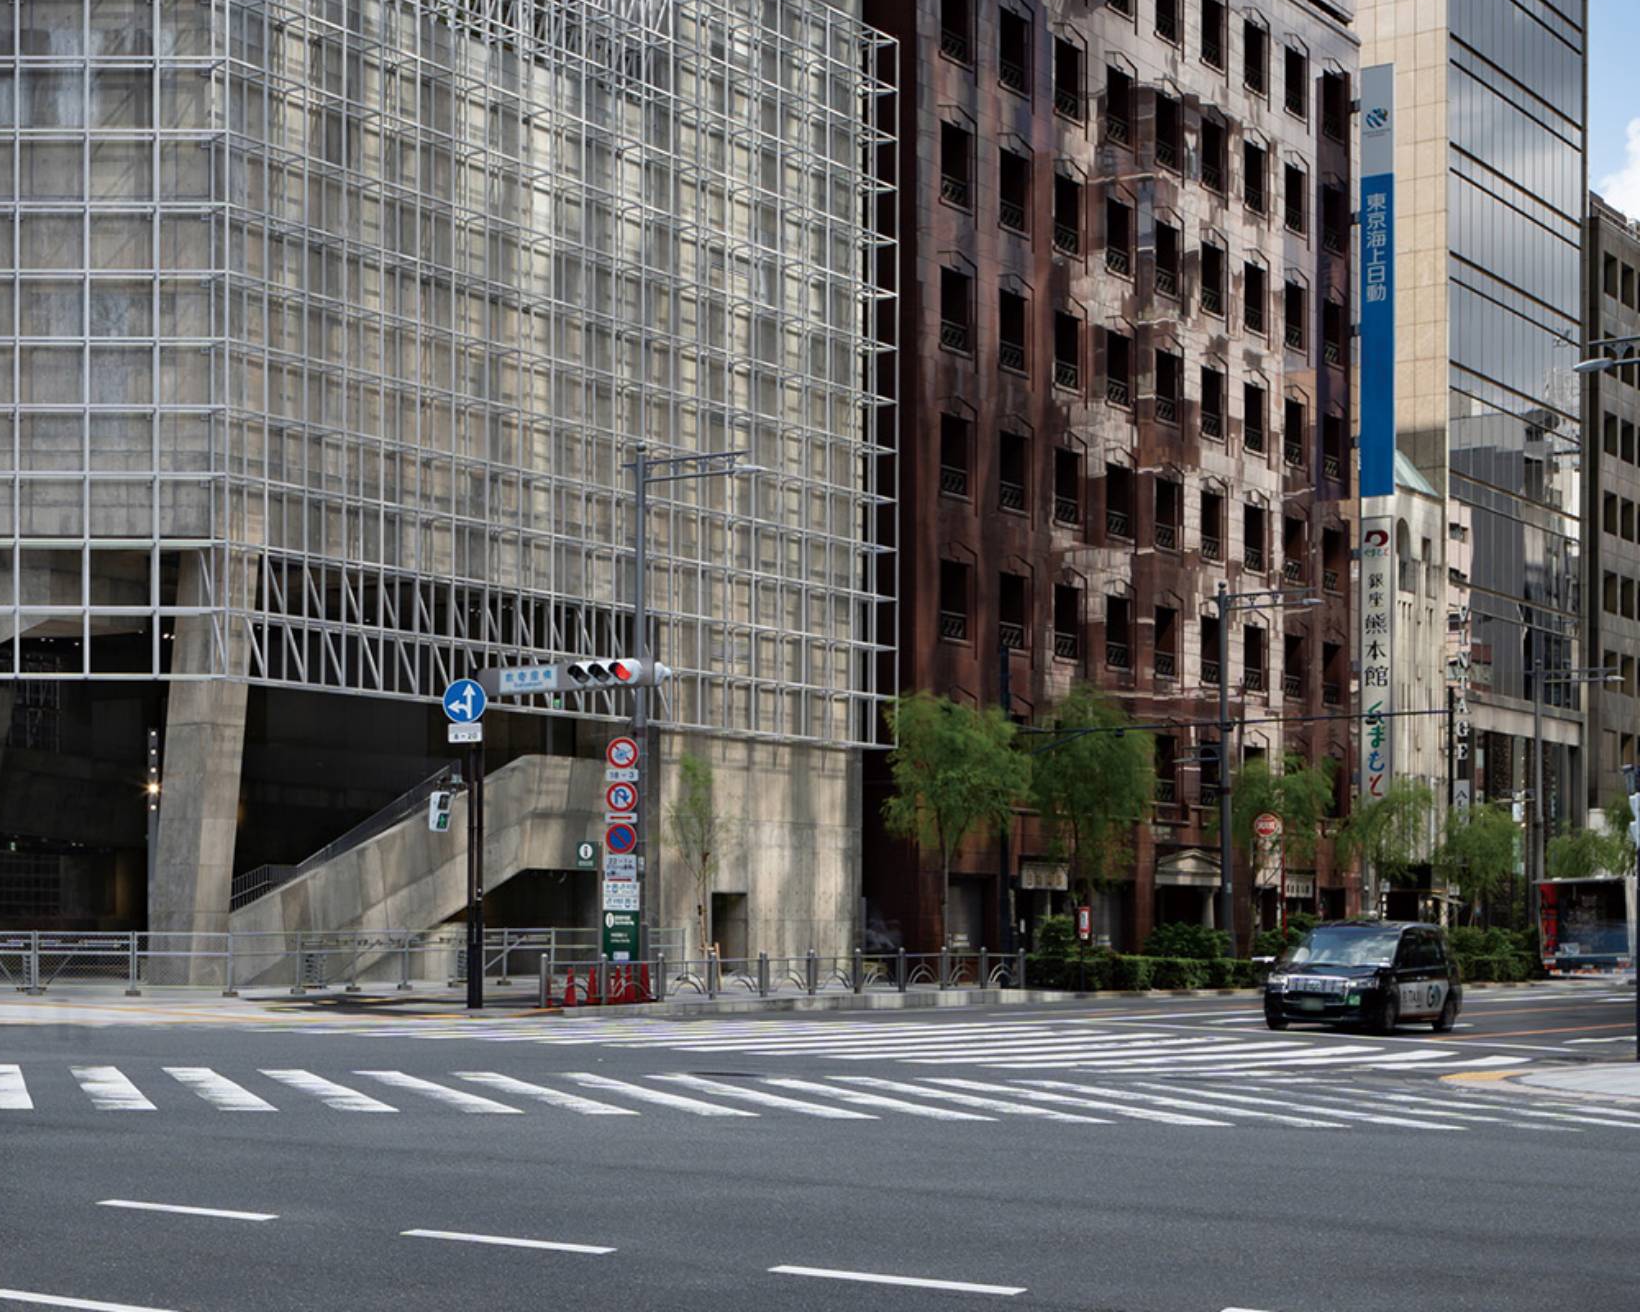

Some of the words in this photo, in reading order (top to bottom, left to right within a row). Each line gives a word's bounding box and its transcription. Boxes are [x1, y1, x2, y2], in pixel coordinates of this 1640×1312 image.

[1366, 192, 1387, 303] 東京海上日動
[1364, 572, 1389, 688] 銀座熊本館
[1366, 700, 1386, 797] くまもと
